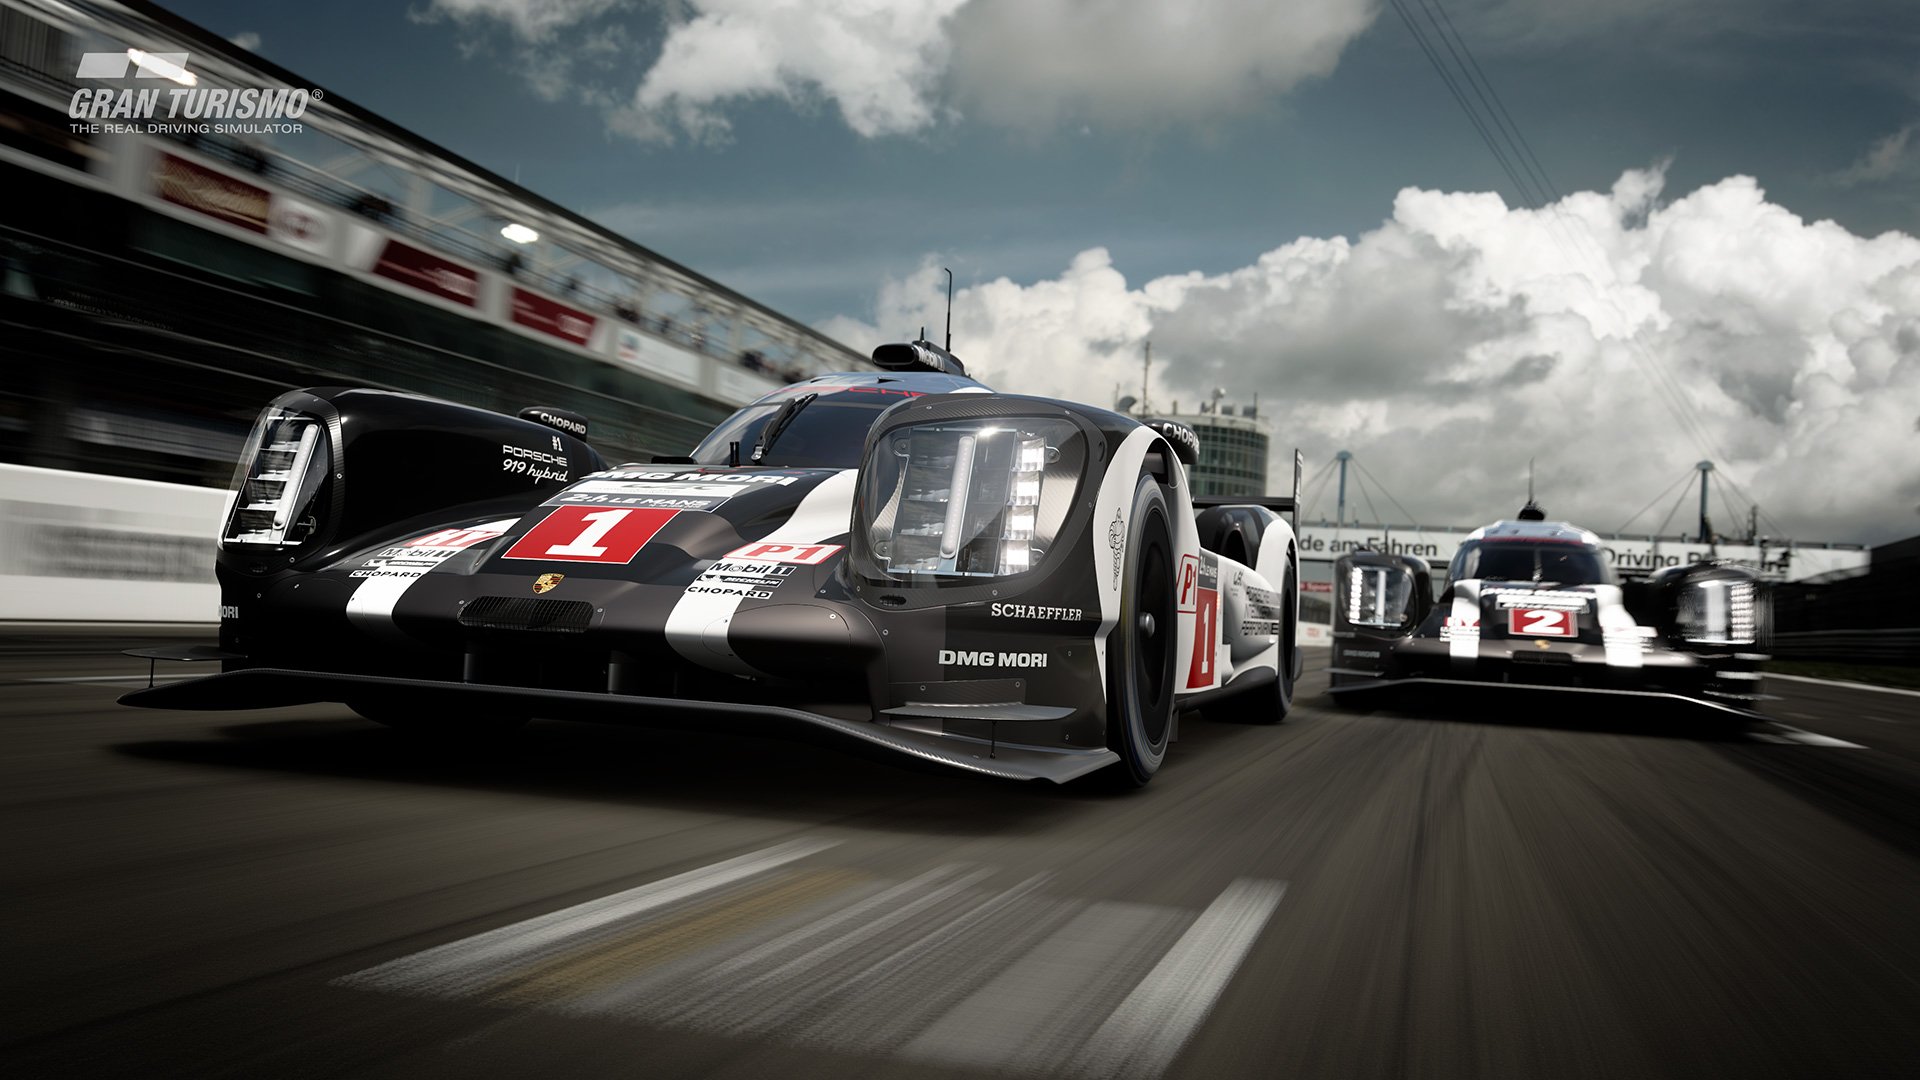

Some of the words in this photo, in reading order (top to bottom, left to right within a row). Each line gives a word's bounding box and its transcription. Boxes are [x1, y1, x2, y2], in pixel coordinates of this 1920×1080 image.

[540, 412, 587, 435] CHOPARD
[552, 435, 563, 452] #1
[502, 444, 568, 467] PORSCHE
[502, 458, 527, 474] 919
[526, 463, 569, 485] hybrid
[673, 472, 799, 486] MORI
[545, 508, 634, 557] 1
[745, 545, 825, 560] P1
[709, 563, 771, 574] Mobil
[687, 586, 770, 598] CHOPARD
[1180, 563, 1197, 606] P1
[991, 603, 1082, 621] SCHAEFFLER
[1523, 610, 1564, 634] 2
[1201, 603, 1209, 674] 1
[938, 650, 995, 667] DMG
[998, 652, 1048, 668] MORI
